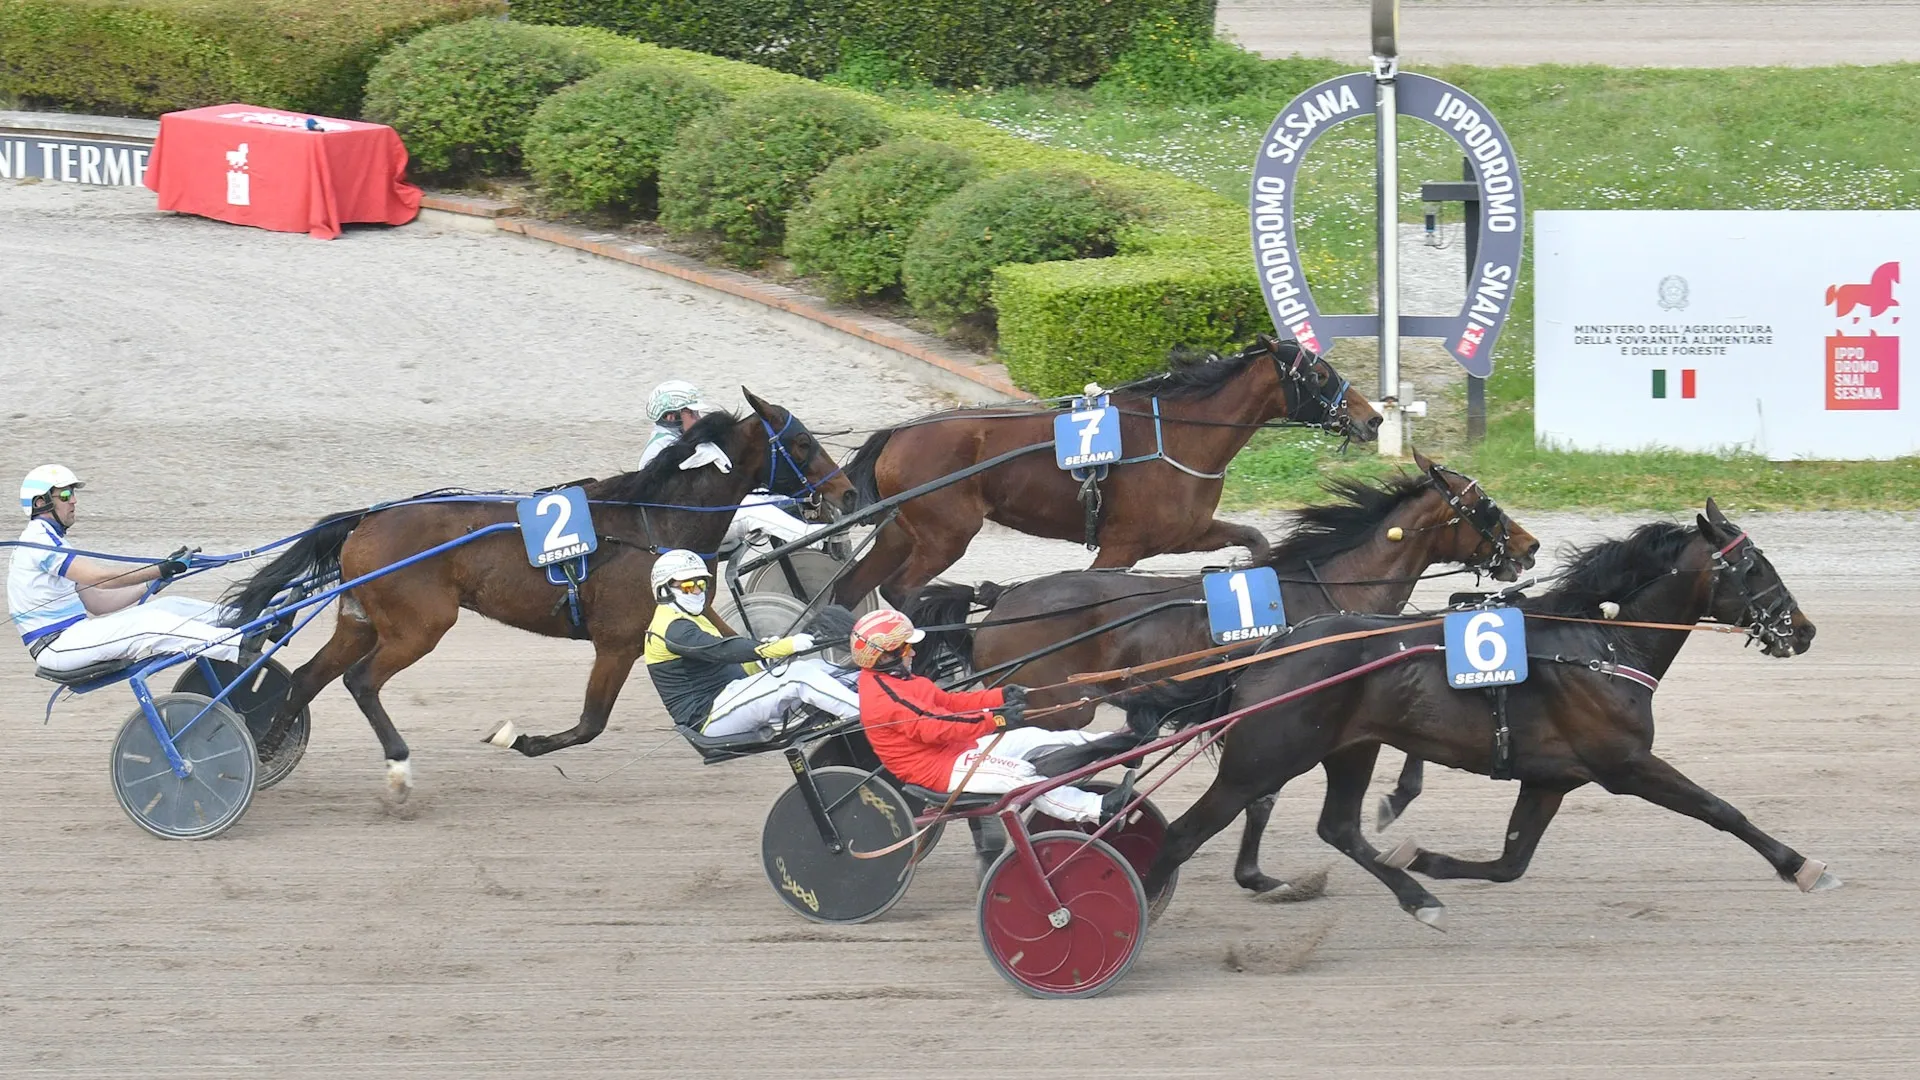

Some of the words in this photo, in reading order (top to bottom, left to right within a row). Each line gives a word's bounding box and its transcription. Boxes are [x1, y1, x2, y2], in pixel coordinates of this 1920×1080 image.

[1266, 85, 1360, 164] SESANA
[1434, 92, 1516, 233] IPPODROMO
[1256, 176, 1310, 327] IPPODROMO
[1467, 262, 1512, 327] SNAI
[1574, 325, 1646, 334] MINISTERO
[1650, 325, 1773, 334] DELL'AGRICOLTURA
[1574, 336, 1612, 345] DELLA
[1692, 336, 1773, 345] ALIMENTARE
[1621, 347, 1628, 356] E
[1631, 347, 1668, 356] DELLE
[1672, 347, 1727, 356] FORESTE
[1834, 347, 1865, 360] IPPO
[1834, 360, 1879, 373] DROMO
[1834, 374, 1865, 386] SNAI
[1834, 387, 1883, 400] SESANA
[1071, 408, 1106, 455] 7
[1064, 451, 1114, 466] SESANA
[536, 494, 580, 552] 2
[538, 542, 590, 564] SESANA
[1229, 572, 1254, 628] 1
[1222, 625, 1278, 642] SESANA
[1464, 612, 1507, 671] 6
[1455, 670, 1516, 685] SESANA
